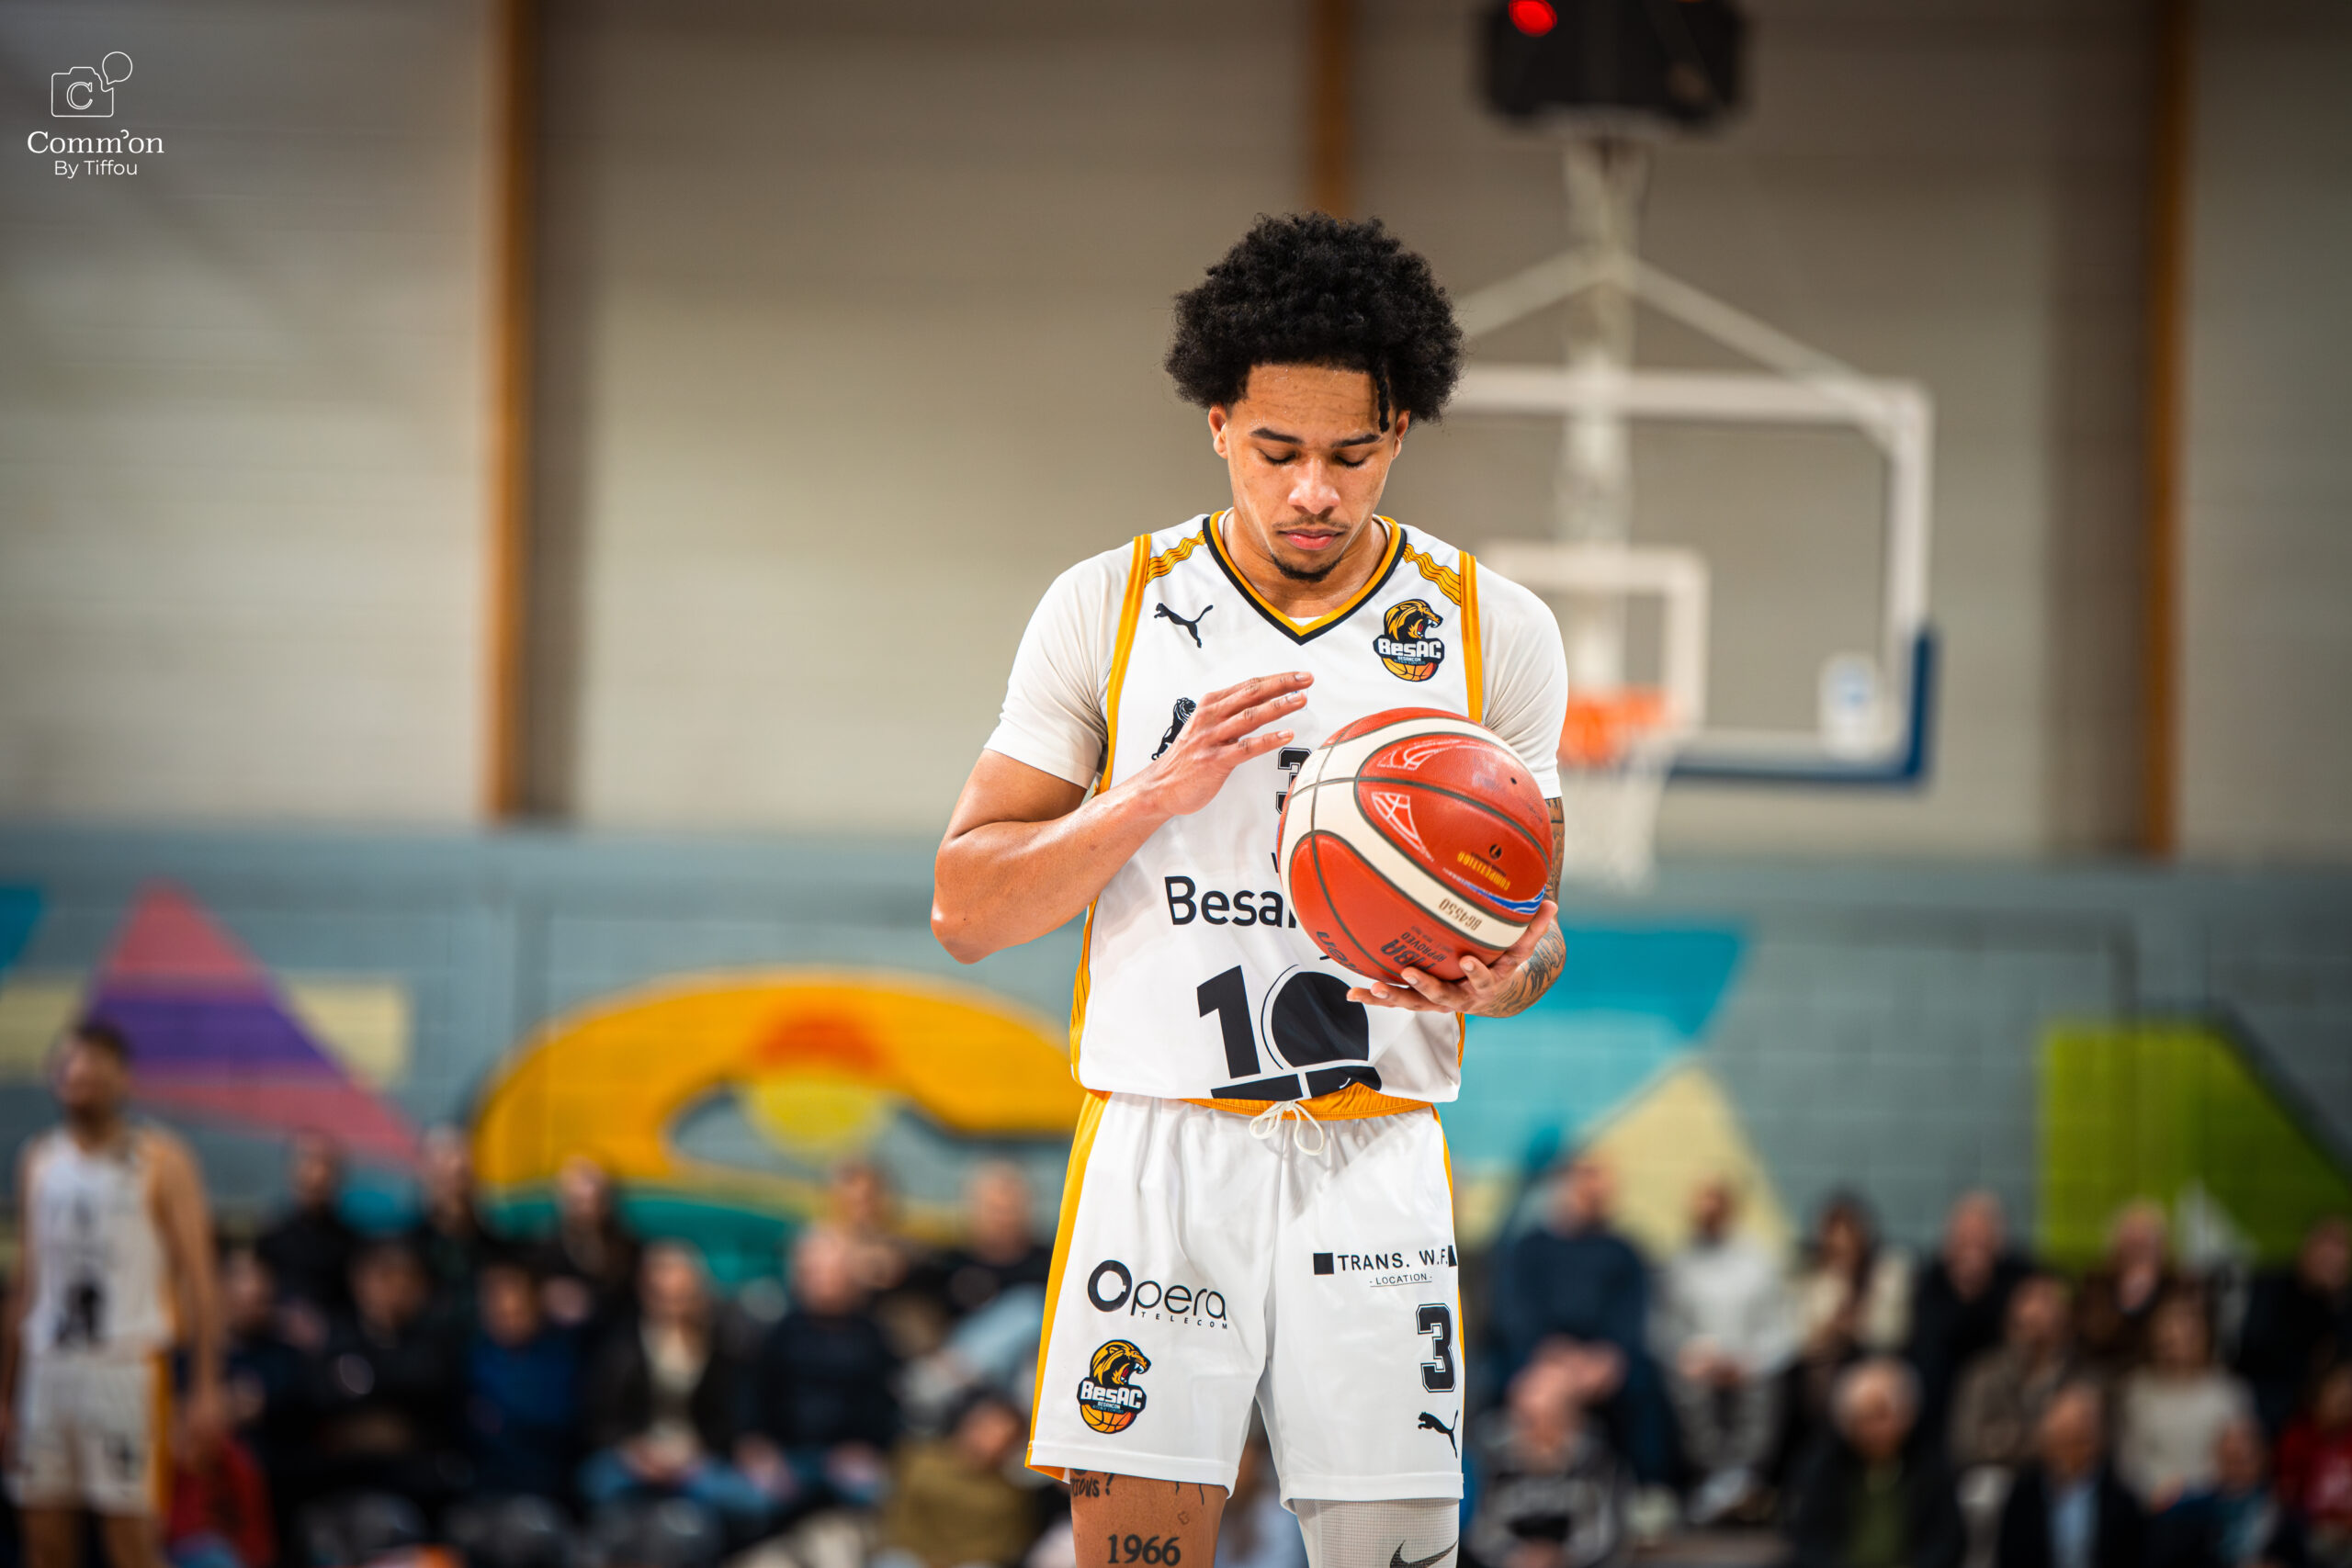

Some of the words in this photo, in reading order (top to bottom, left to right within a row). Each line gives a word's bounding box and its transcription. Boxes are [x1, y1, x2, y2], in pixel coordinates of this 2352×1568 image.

[1377, 637, 1442, 659] BesAC
[1439, 897, 1483, 931] BG4550
[1401, 931, 1448, 963] APPROVED
[1337, 1253, 1410, 1271] TRANS.
[1087, 1259, 1227, 1322] Opera
[1374, 1274, 1429, 1286] LOCATION
[1140, 1311, 1228, 1330] TELECOM
[1416, 1303, 1456, 1393] 3
[1080, 1380, 1143, 1410] BesAC
[1107, 1533, 1182, 1565] 1966
